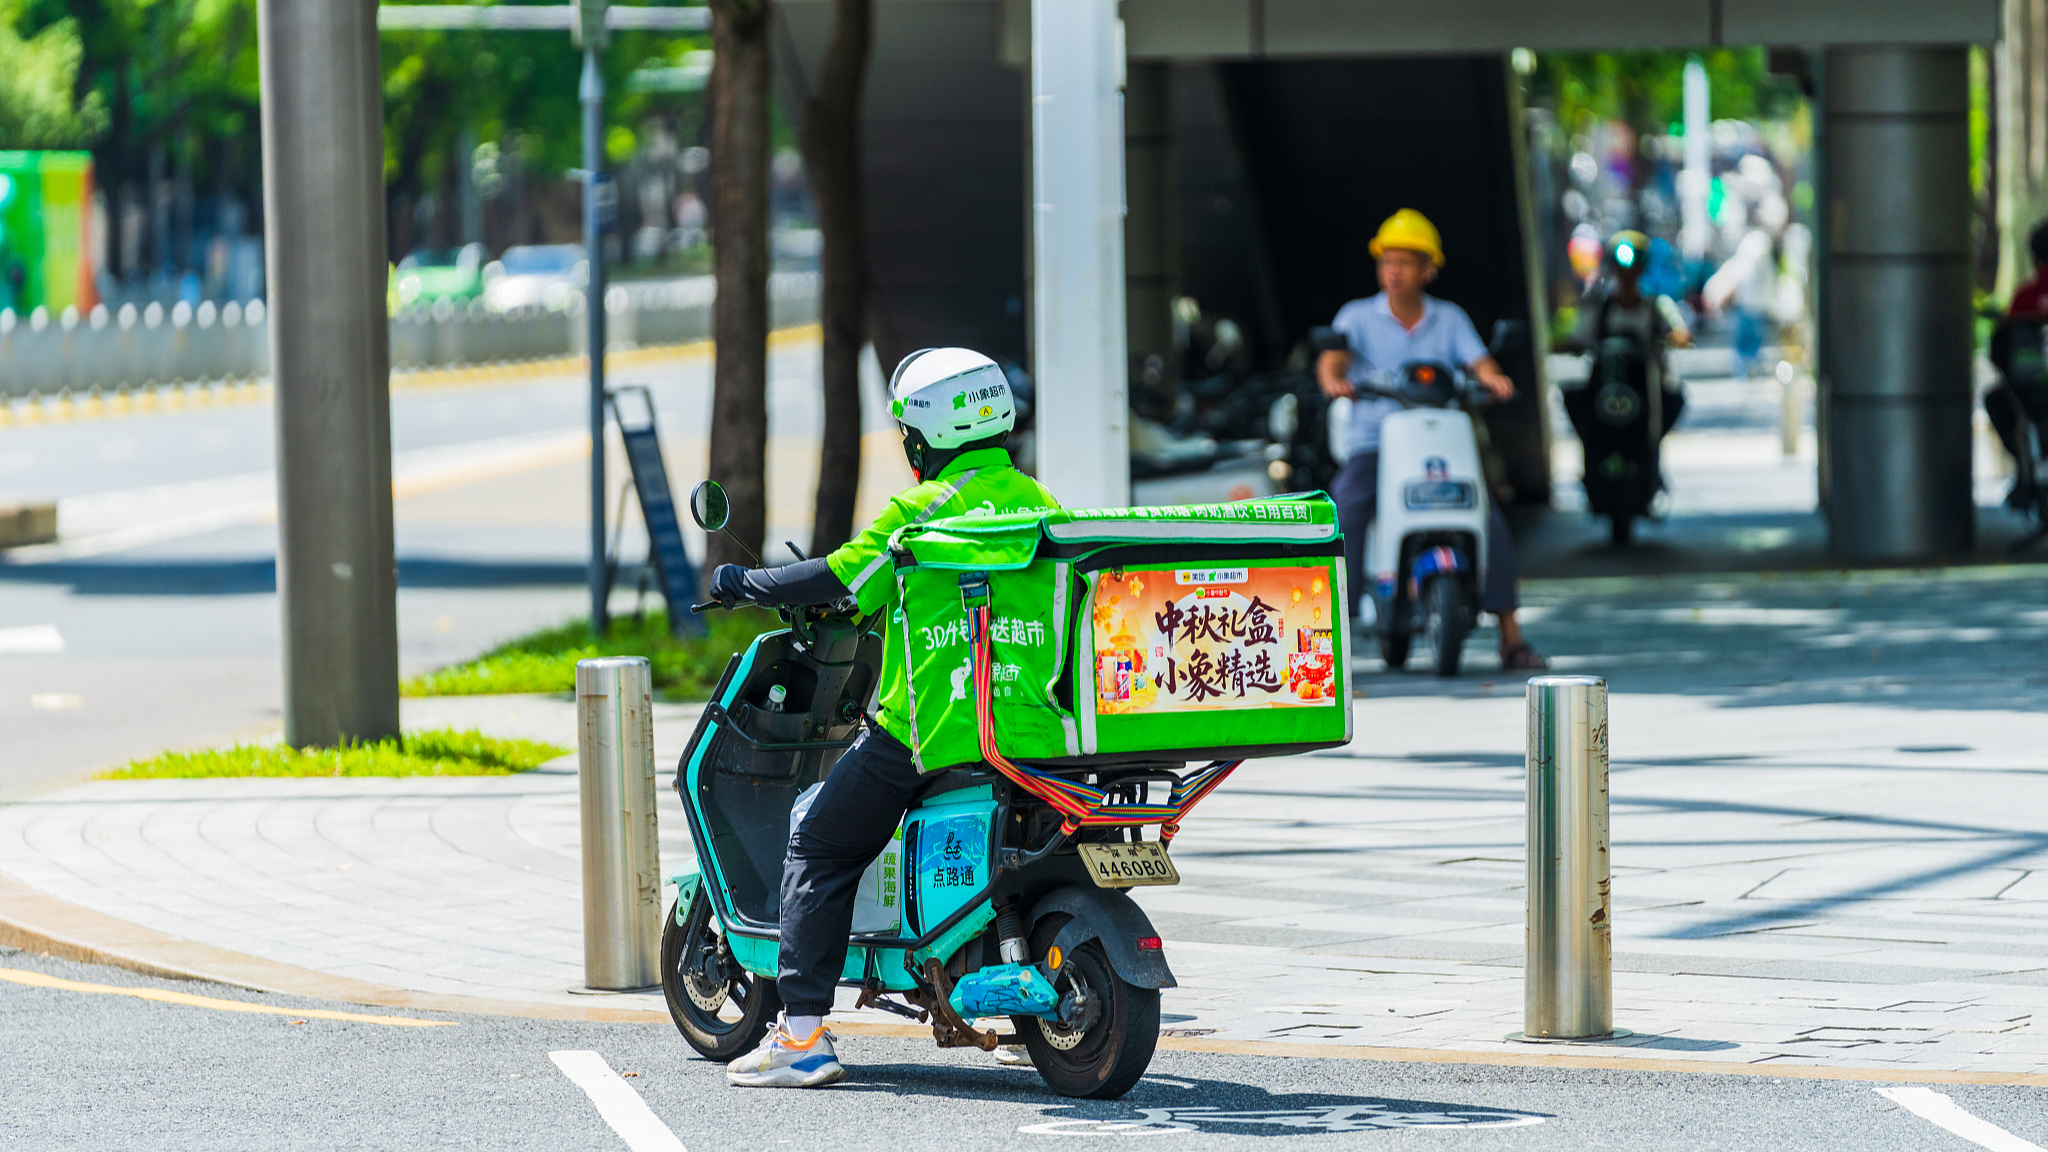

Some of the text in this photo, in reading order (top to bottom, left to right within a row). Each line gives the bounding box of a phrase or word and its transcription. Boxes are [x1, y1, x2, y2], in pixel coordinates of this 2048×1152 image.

[908, 399, 931, 409] 小象超市
[968, 385, 1006, 404] 小象超市
[1217, 571, 1243, 581] 小象超市
[1155, 595, 1281, 652] 中秋礼盒
[1155, 648, 1285, 703] 小象精选
[933, 865, 975, 888] 点路通
[1100, 860, 1167, 877] 4460B0
[882, 852, 897, 908] 蔬果海鲜
